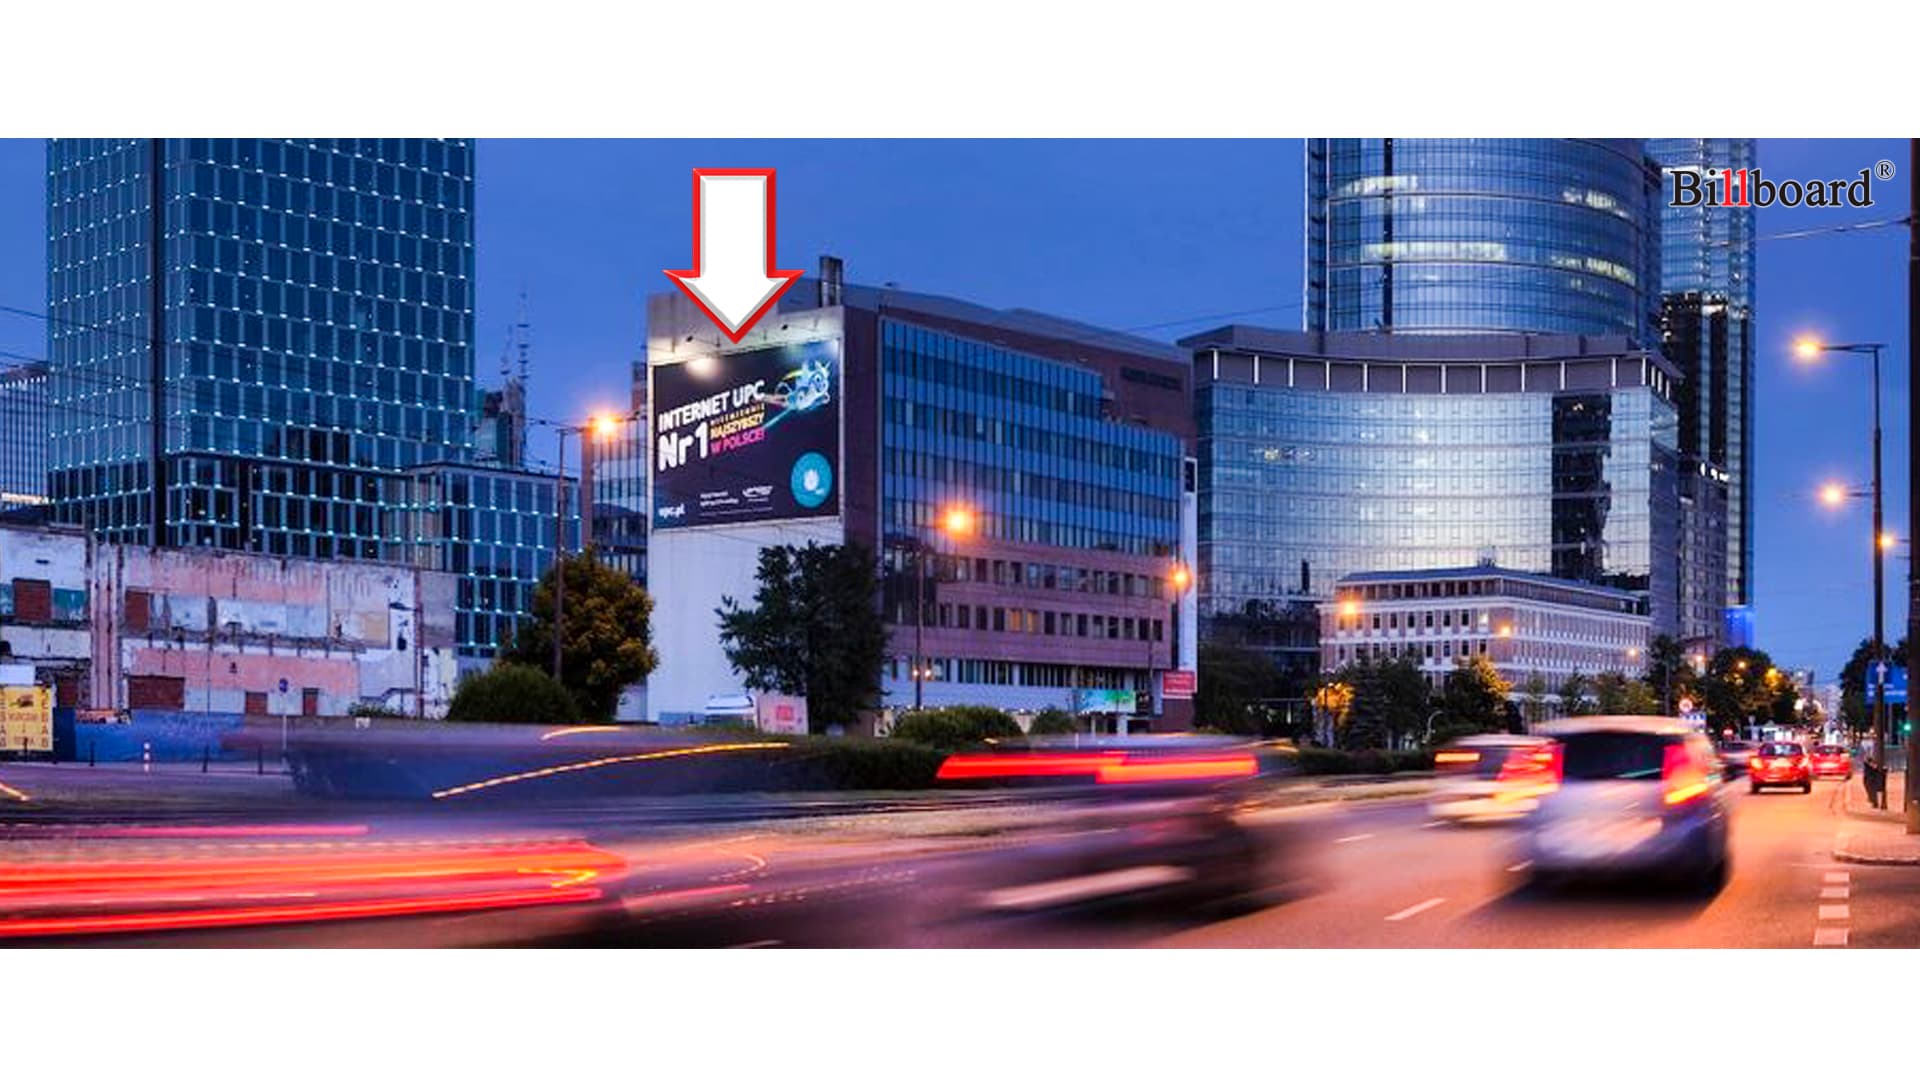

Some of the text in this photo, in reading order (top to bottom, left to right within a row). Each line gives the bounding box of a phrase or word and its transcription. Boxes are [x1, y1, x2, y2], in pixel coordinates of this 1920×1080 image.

[658, 380, 765, 433] INTERNET UPC
[658, 421, 708, 471] Nr 1
